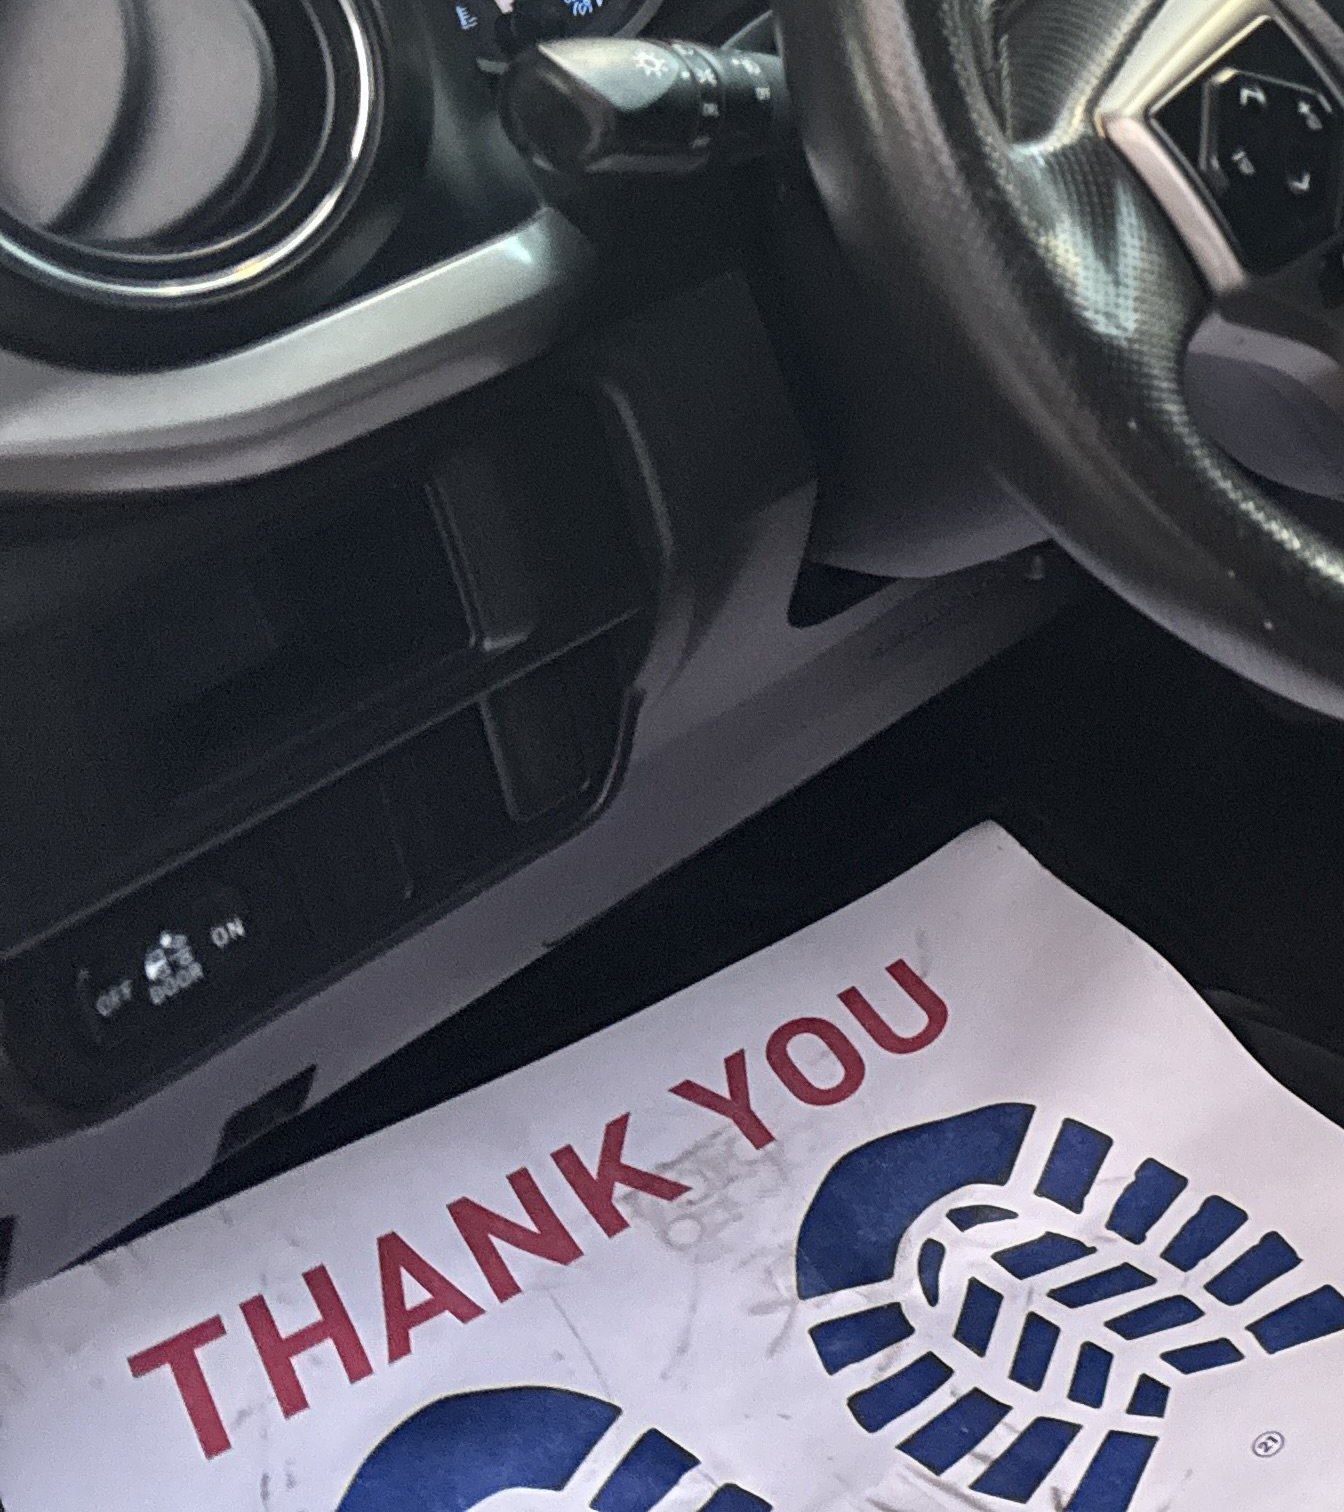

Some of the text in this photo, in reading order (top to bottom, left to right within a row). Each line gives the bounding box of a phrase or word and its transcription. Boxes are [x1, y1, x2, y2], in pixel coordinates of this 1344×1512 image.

[210, 916, 246, 948] ON
[97, 979, 133, 1017] OFF
[127, 959, 949, 1460] THANK YOU
